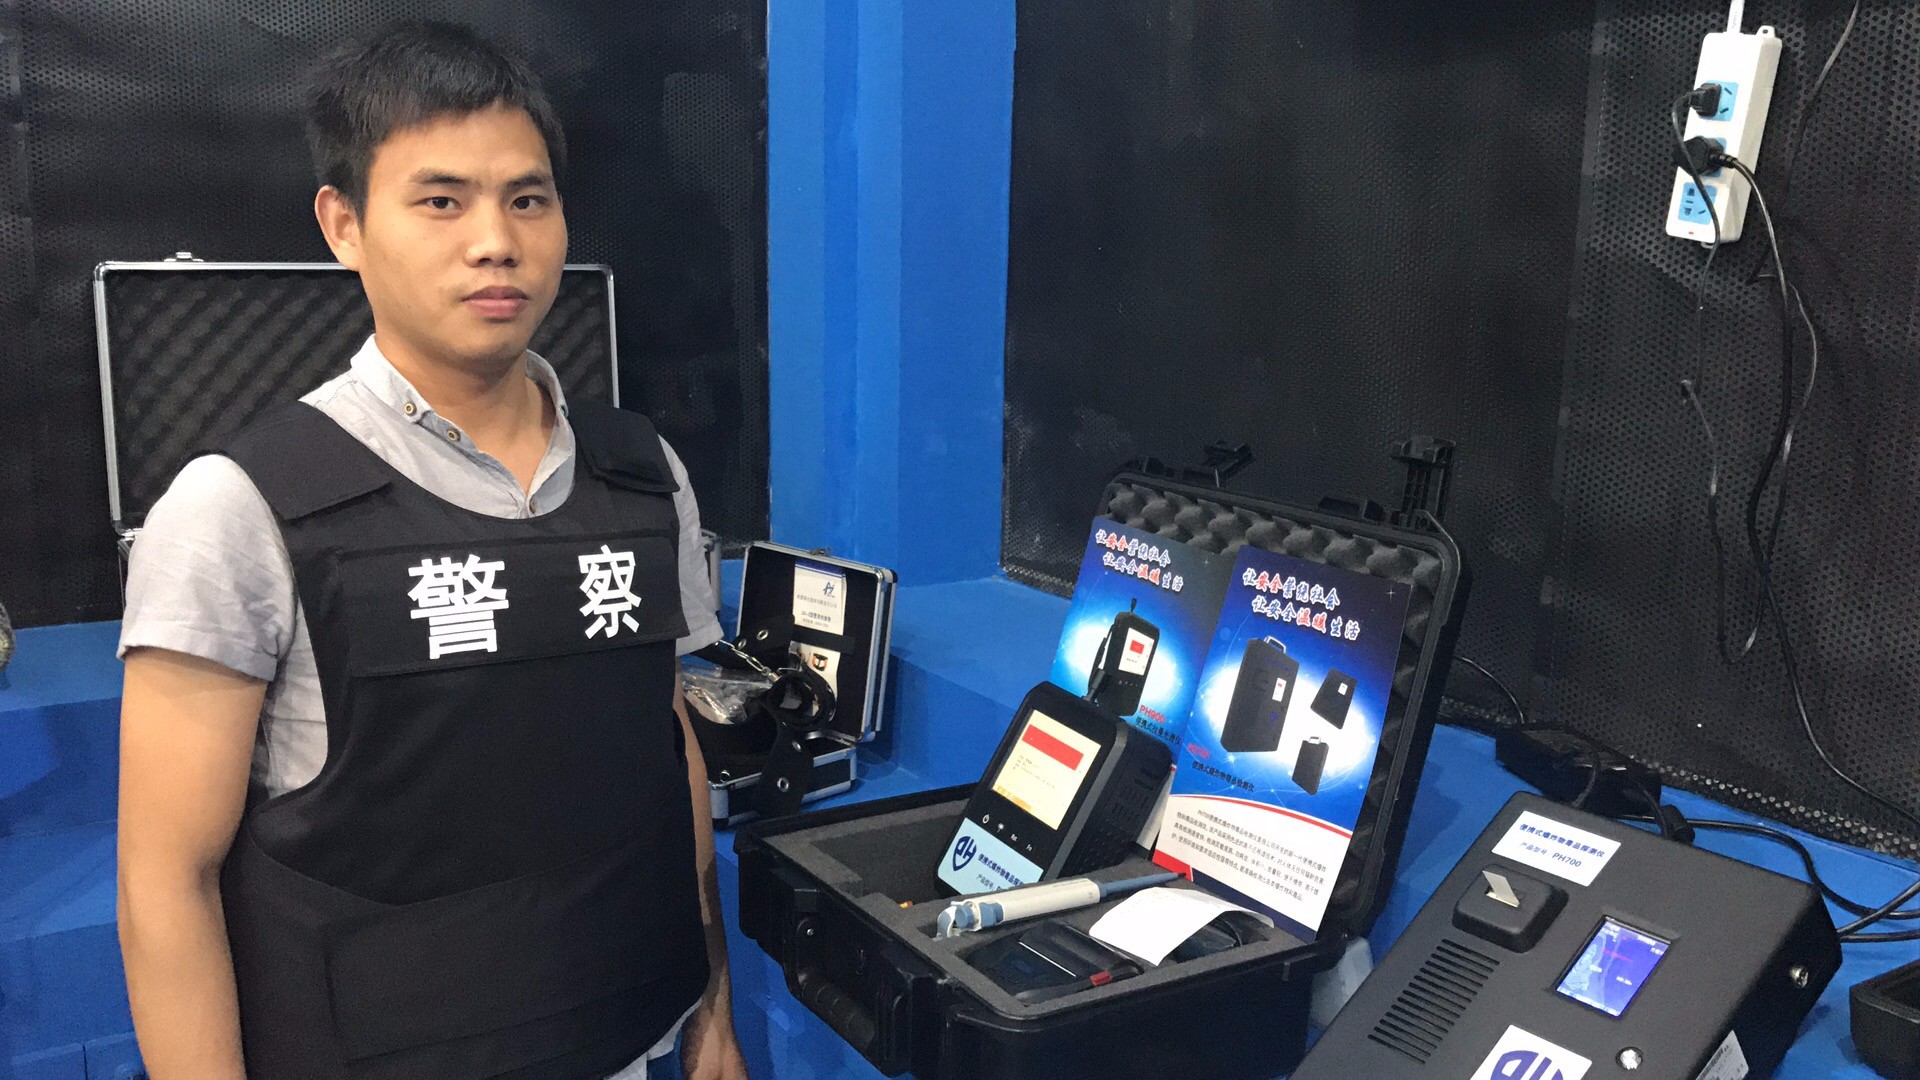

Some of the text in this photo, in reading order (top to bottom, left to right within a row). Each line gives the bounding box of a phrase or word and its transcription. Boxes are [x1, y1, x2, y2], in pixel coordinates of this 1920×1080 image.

[1102, 553, 1184, 592] 让安全温暖生活
[407, 544, 642, 660] 警 察
[1251, 595, 1361, 641] 让安全温暖生活
[1140, 704, 1166, 724] PH900
[1519, 822, 1606, 859] 便携式爆炸物毒品探测仪
[1519, 841, 1582, 868] 产品型号 PH700
